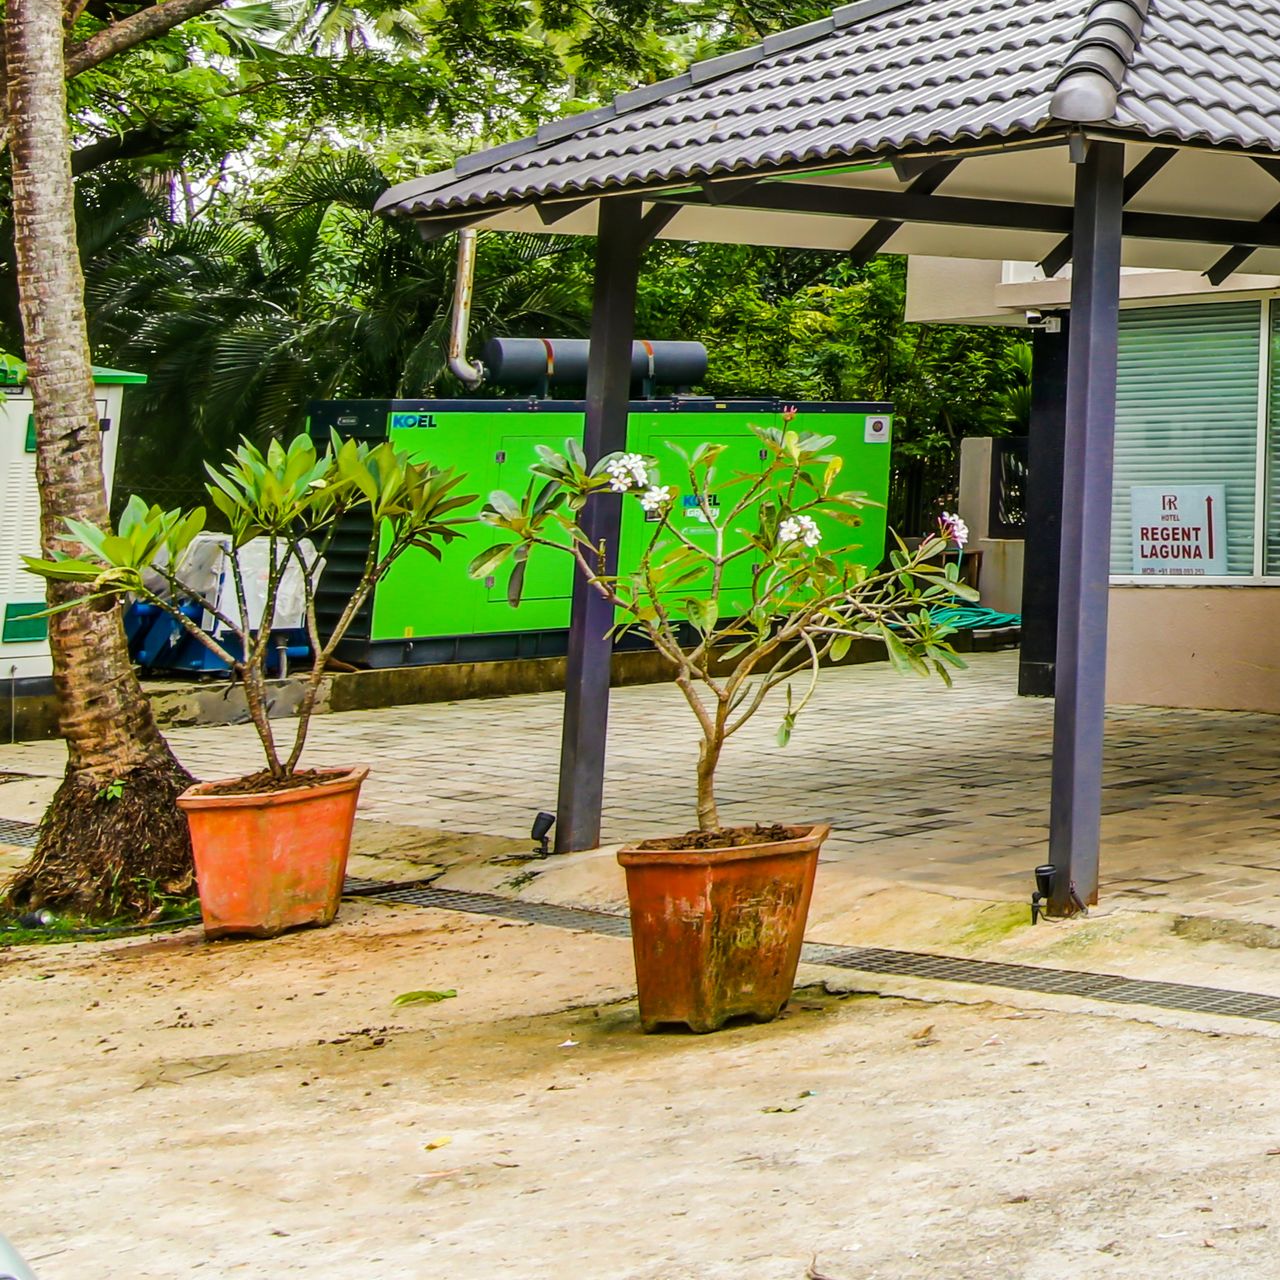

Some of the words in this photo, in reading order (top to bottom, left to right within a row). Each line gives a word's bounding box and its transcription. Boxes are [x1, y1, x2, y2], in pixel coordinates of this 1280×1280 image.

[393, 414, 437, 428] KOEL
[1161, 514, 1180, 522] HOTEL
[1140, 527, 1201, 541] REGENT
[1140, 544, 1203, 559] LAGUNA
